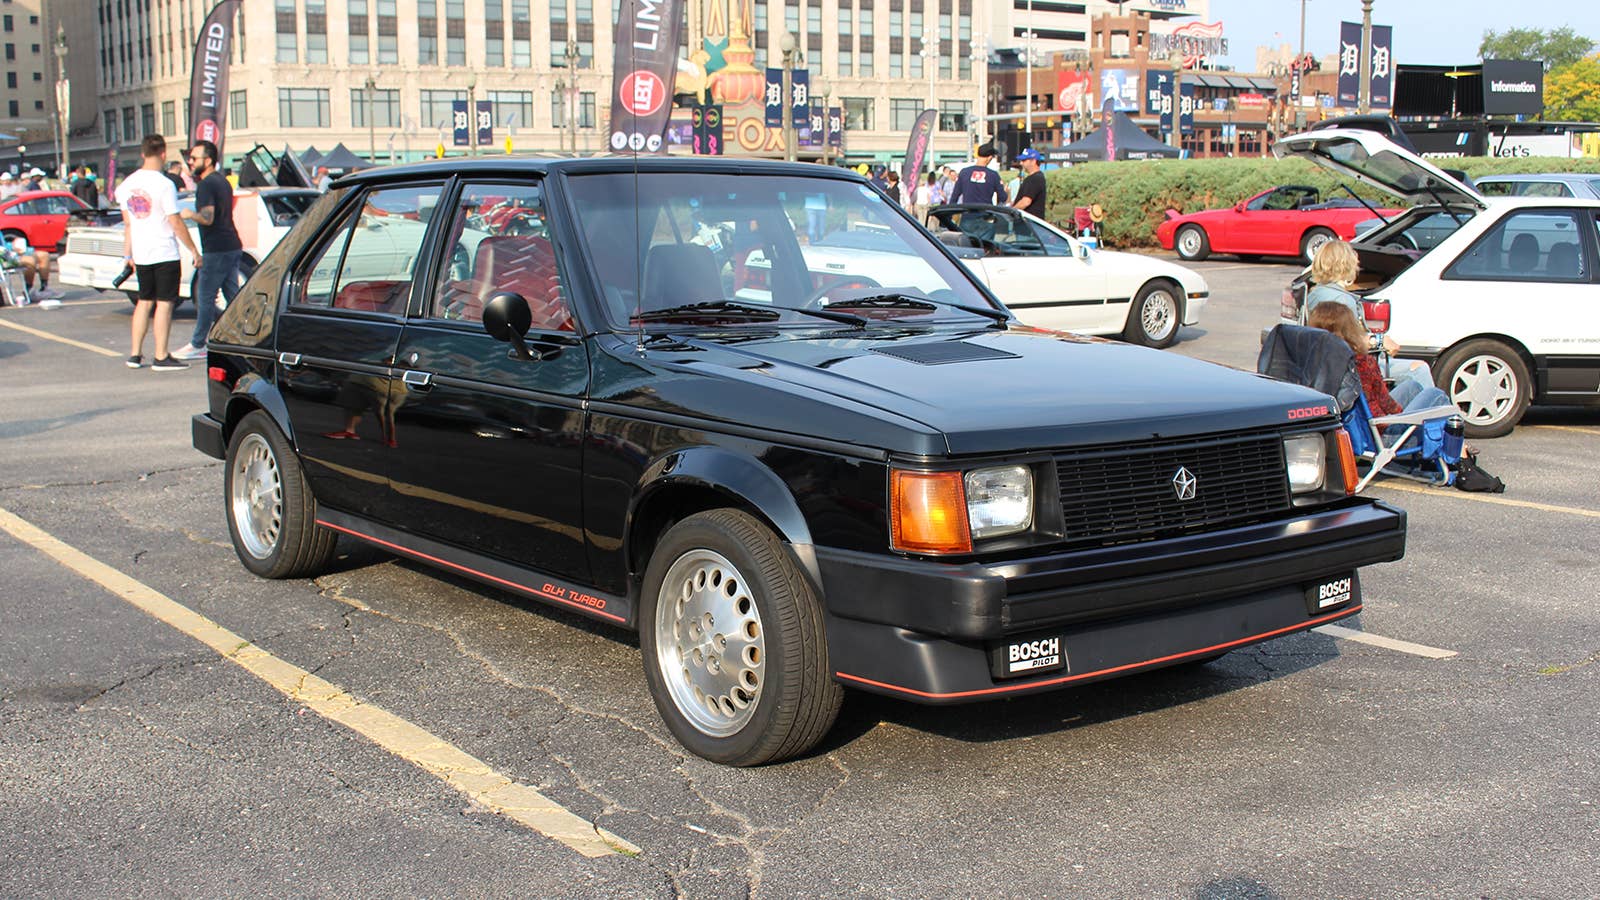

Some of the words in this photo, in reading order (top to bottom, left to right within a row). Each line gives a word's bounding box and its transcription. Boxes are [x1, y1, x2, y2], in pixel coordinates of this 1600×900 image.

[633, 0, 663, 51] LIM
[201, 22, 225, 108] LIMITED
[1491, 80, 1536, 93] Information
[1288, 406, 1329, 420] DODGE
[542, 583, 566, 597] GLH
[569, 590, 607, 609] TURBO
[1319, 577, 1351, 600] BOSCH
[1009, 637, 1059, 662] BOSCH
[1032, 657, 1055, 667] PILOT
